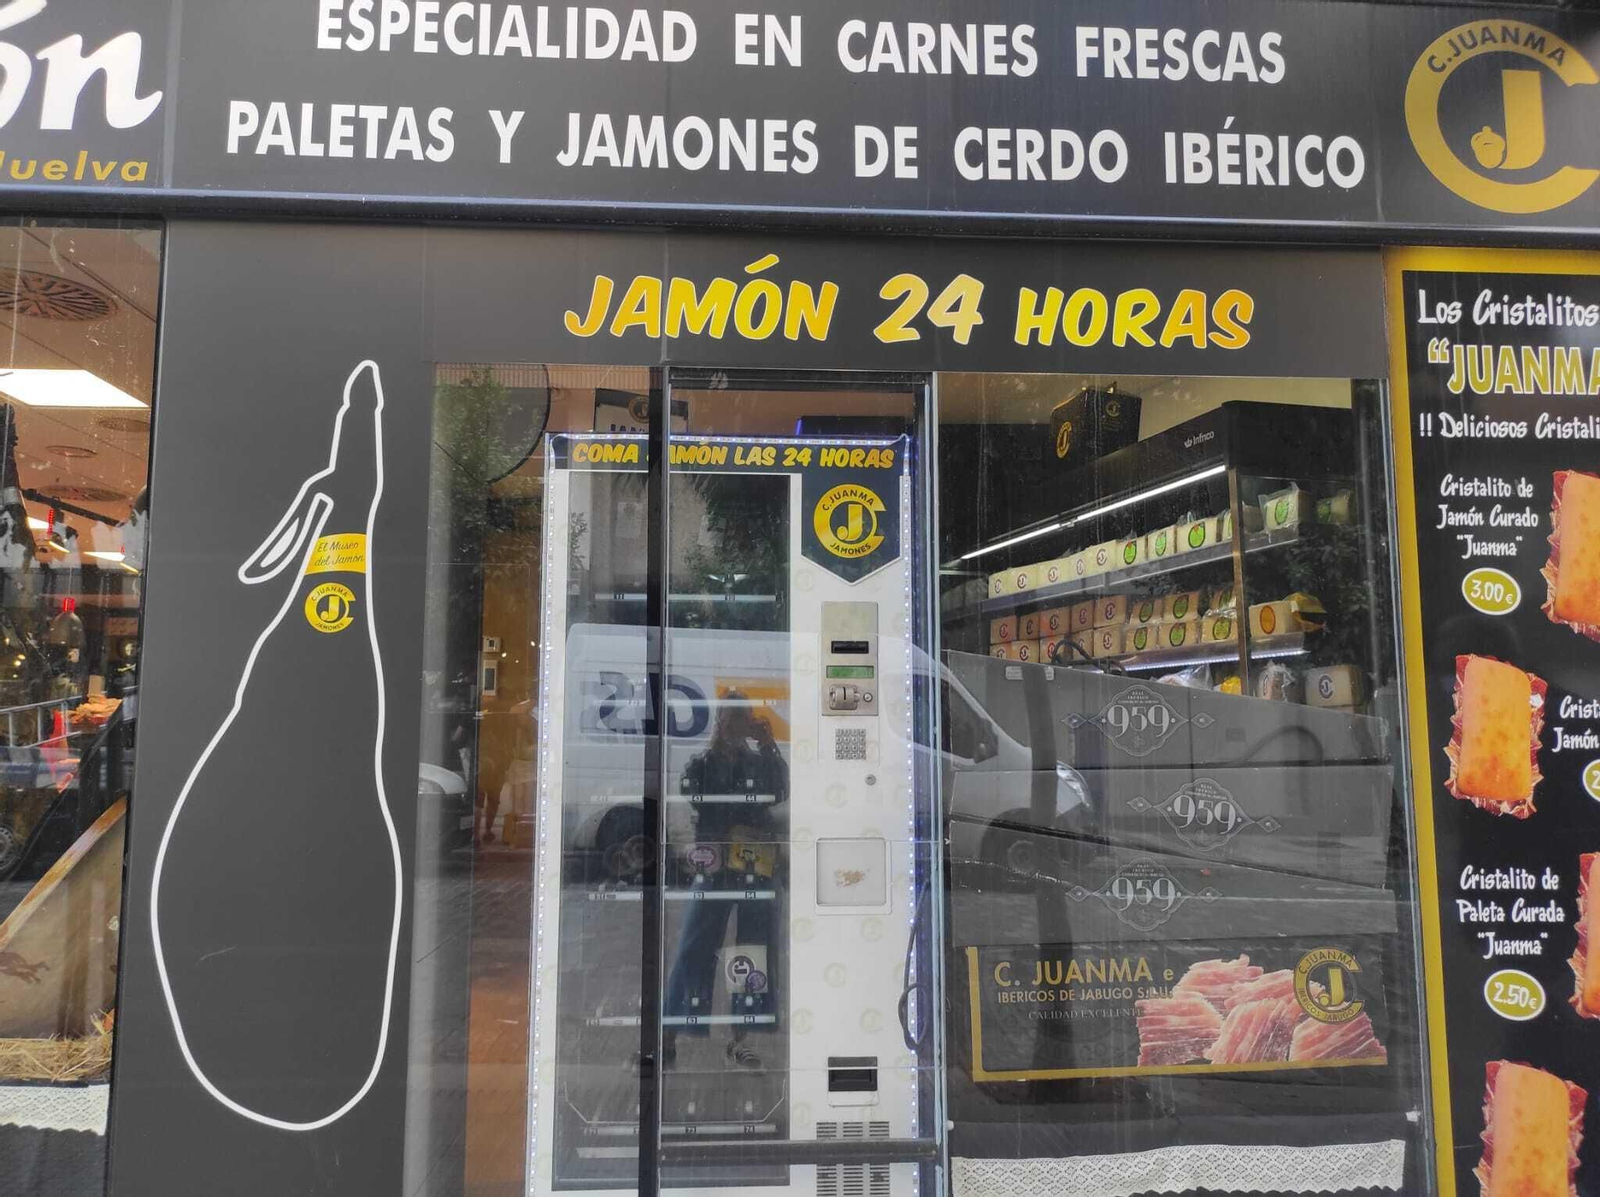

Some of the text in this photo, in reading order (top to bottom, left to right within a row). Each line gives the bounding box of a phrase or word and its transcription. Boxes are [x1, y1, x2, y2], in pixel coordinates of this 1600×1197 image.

[317, 0, 1286, 84] ESPECIALIDAD EN CARNES FRESCAS
[227, 100, 1365, 188] PALETAS Y JAMONES DE CERDO IBÉRICO
[0, 151, 148, 181] uelva
[564, 254, 1255, 350] JAMÓN 24 HORAS
[1417, 288, 1600, 326] Los Cristalitos
[1438, 411, 1528, 439] Deliciosos
[572, 443, 639, 464] COMA
[734, 446, 776, 466] LAS
[782, 447, 811, 467] 24
[820, 447, 894, 468] HORAS
[1440, 473, 1533, 498] Cristalito de
[1436, 504, 1539, 529] Jamón Curado
[317, 541, 359, 552] El Museo
[830, 542, 871, 555] JAMONES
[314, 554, 365, 567] del Jamón
[1559, 694, 1600, 719] Crist
[1107, 704, 1170, 738] 959
[1551, 727, 1600, 753] Jamón
[1173, 794, 1236, 835] 959
[1460, 864, 1559, 890] Cristalito de
[1112, 877, 1175, 912] 959
[1456, 897, 1566, 923] Paleta Curada
[994, 957, 1174, 987] C. JUANMA e
[998, 990, 1055, 1004] IBERICOS
[1059, 989, 1076, 1001] DE
[1079, 987, 1134, 1001] JABUGO
[1029, 1009, 1078, 1020] CALIDAD
